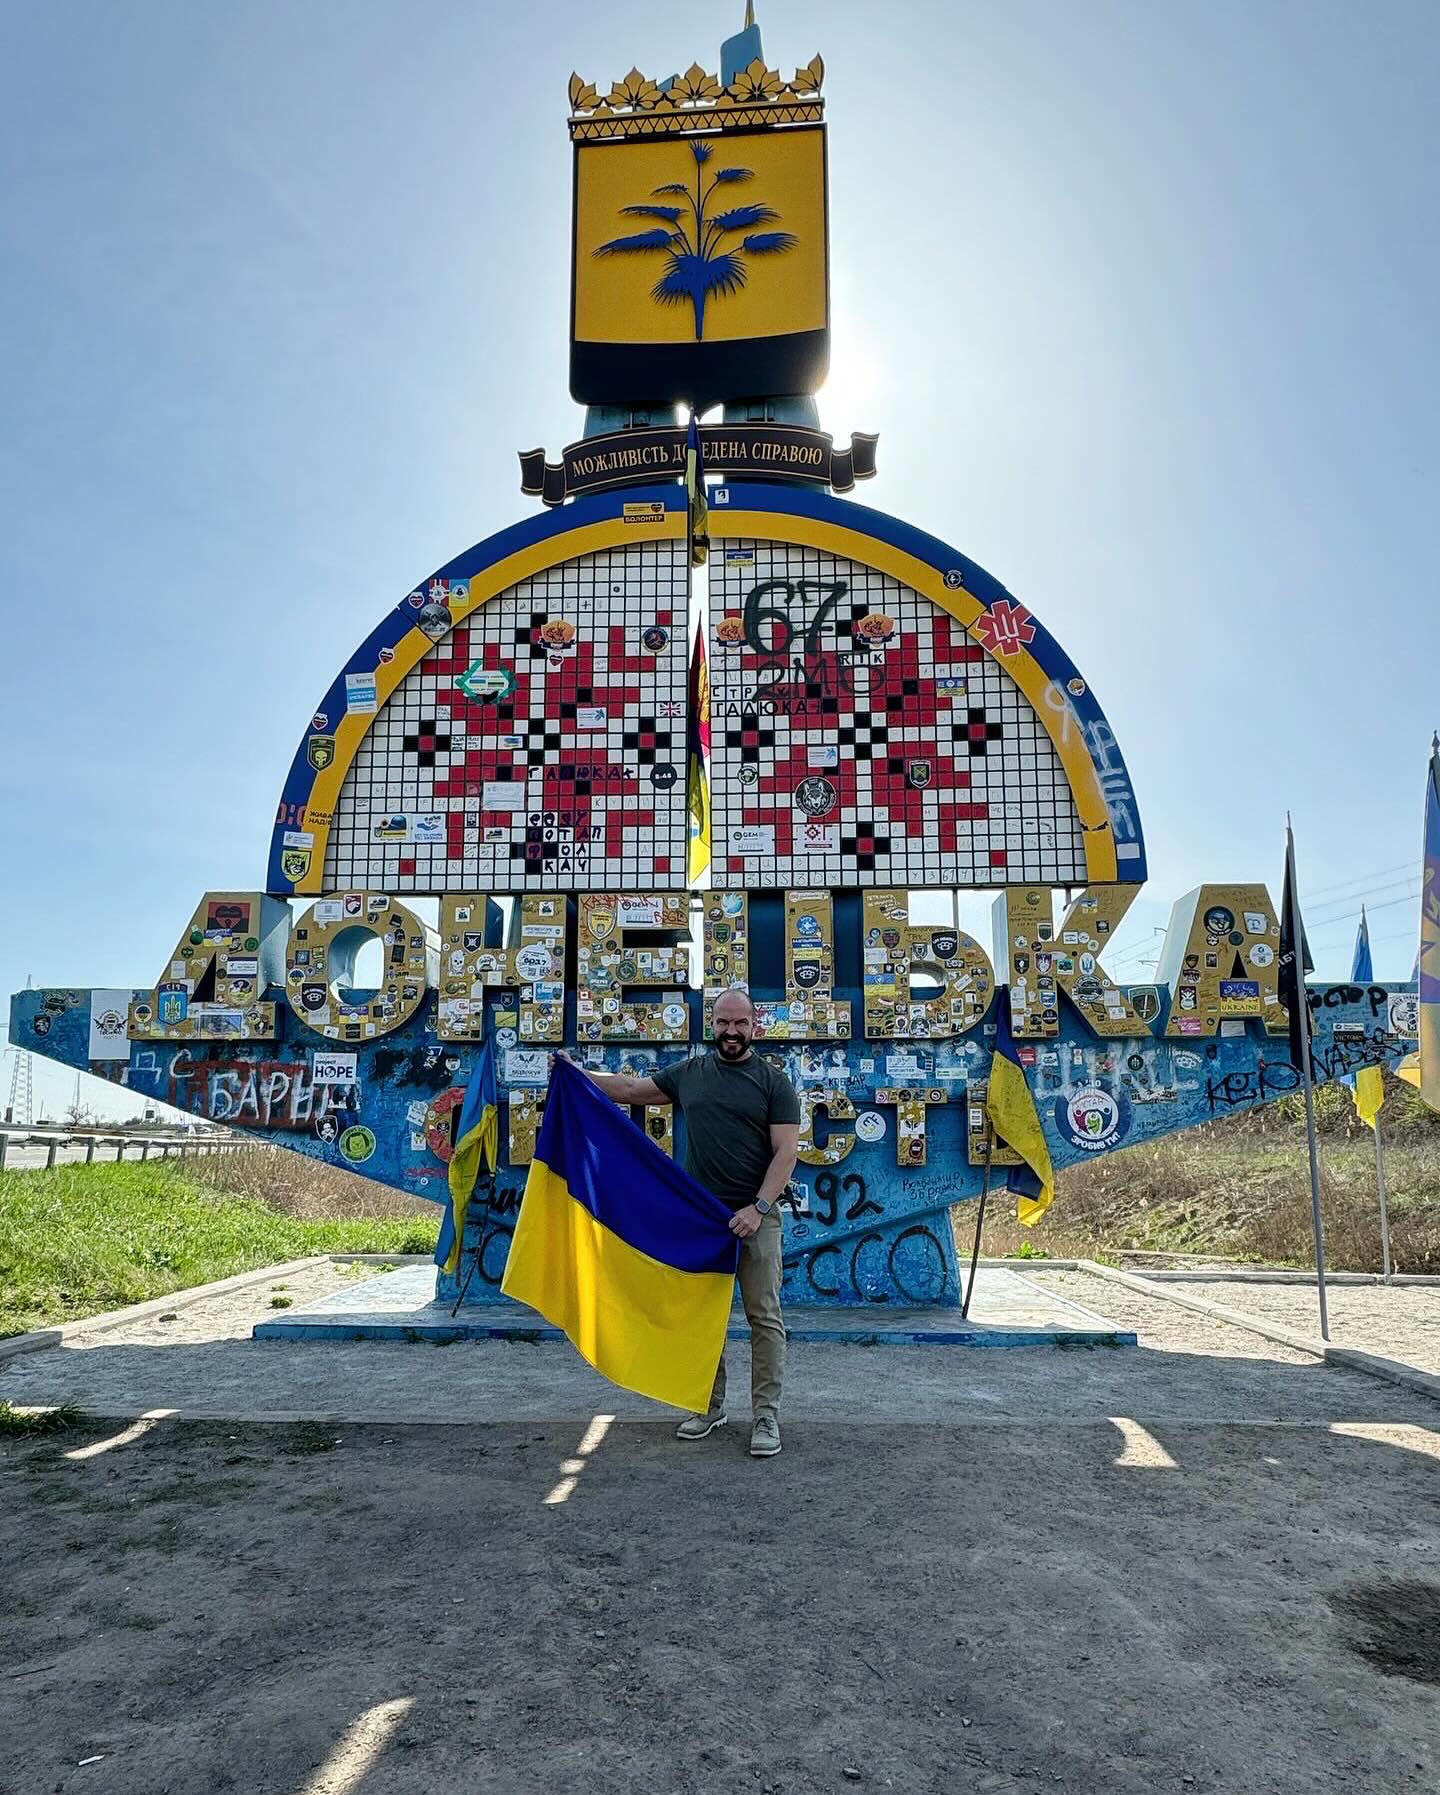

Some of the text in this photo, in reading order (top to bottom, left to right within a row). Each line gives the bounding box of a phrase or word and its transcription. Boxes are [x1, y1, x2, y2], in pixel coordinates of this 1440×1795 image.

[572, 441, 823, 478] МОЖЛИВІСТЬ ДОЕДЕНА СПРАВОЮ
[743, 580, 849, 656] 67
[128, 884, 1318, 1042] ДОНЕЦЬКА
[315, 1065, 354, 1079] HOPE
[1071, 1135, 1106, 1151] ЗРОБИВ
